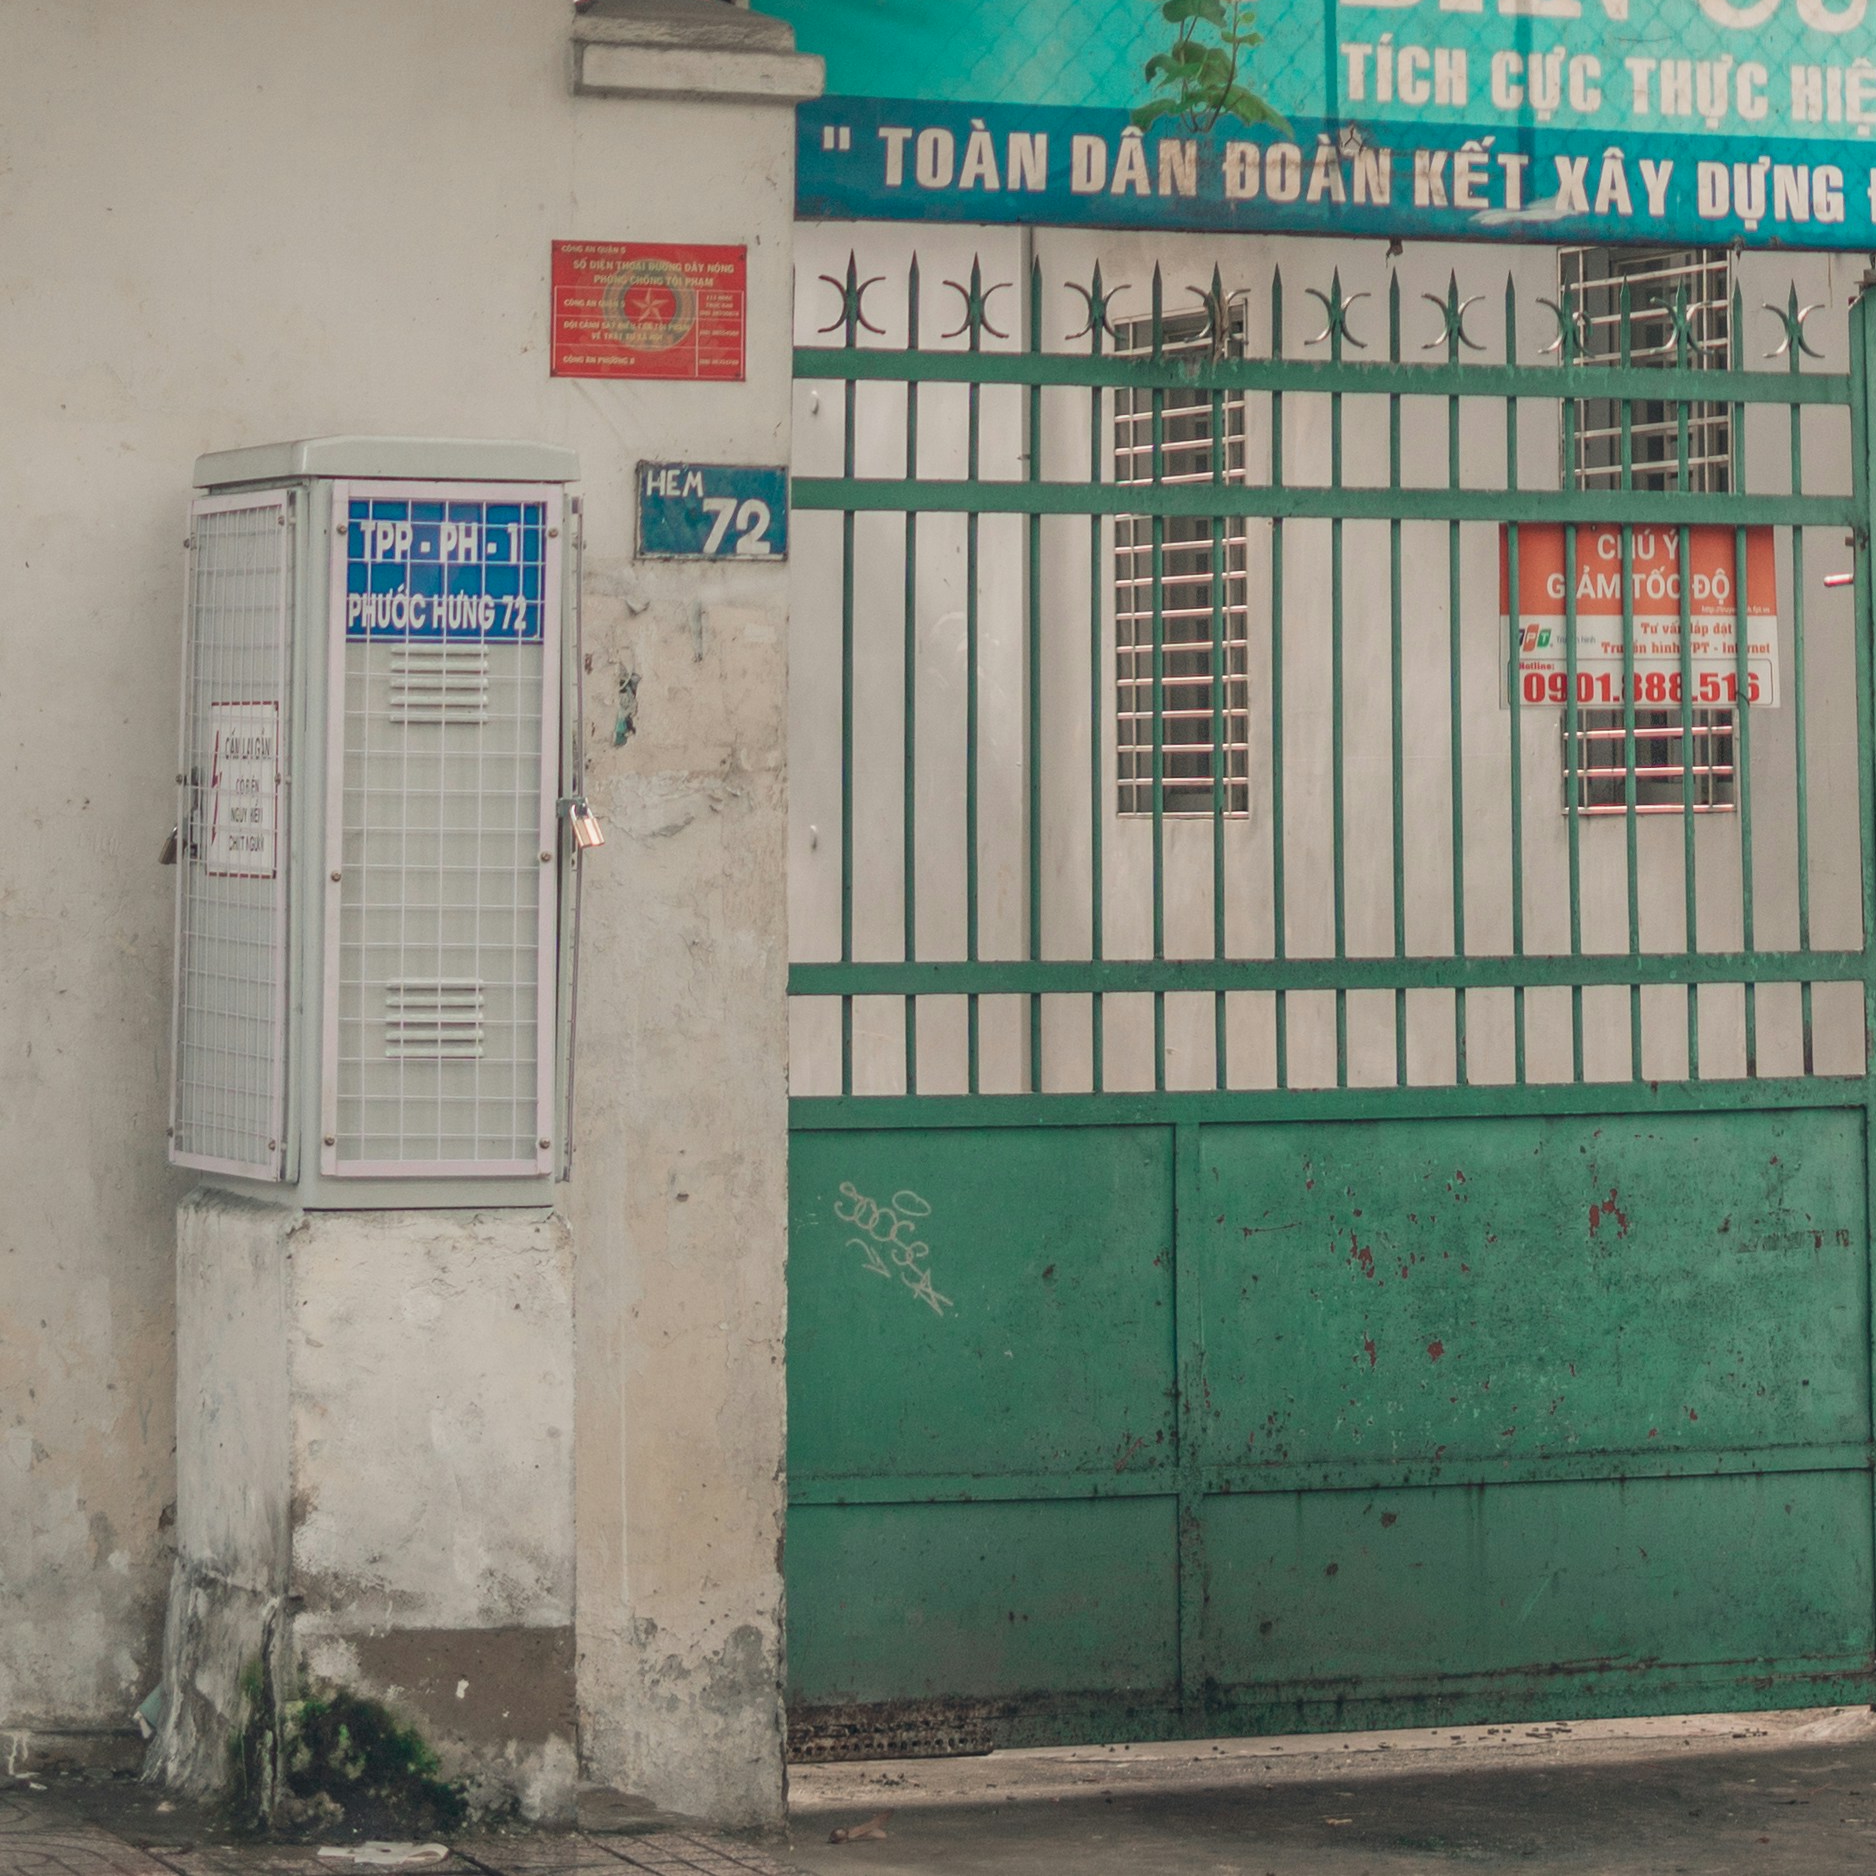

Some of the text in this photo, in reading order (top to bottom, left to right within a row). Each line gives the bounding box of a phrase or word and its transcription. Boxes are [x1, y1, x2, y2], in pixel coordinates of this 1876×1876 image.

[1341, 33, 1468, 107] TÍCH
[1491, 46, 1602, 121] CỰC
[1625, 54, 1770, 130] THỰC
[878, 119, 1048, 192] TOÀN
[1071, 125, 1198, 198] DÂN
[1222, 134, 1391, 205] ĐOÀN
[1414, 135, 1529, 211] KẾT
[1555, 147, 1674, 218] XÂY
[1698, 155, 1846, 230] DỰNG
[360, 521, 413, 562] TPP
[440, 522, 478, 564] PH
[507, 523, 518, 564] 1
[702, 498, 772, 554] 72
[1663, 529, 1680, 560] Ý
[348, 584, 527, 630] PHƯỚC HƯNG 72
[1547, 565, 1621, 599] GẢM
[1692, 568, 1730, 605] ĐỘ
[1601, 638, 1646, 654] Truền
[1722, 641, 1770, 654] Intrnet
